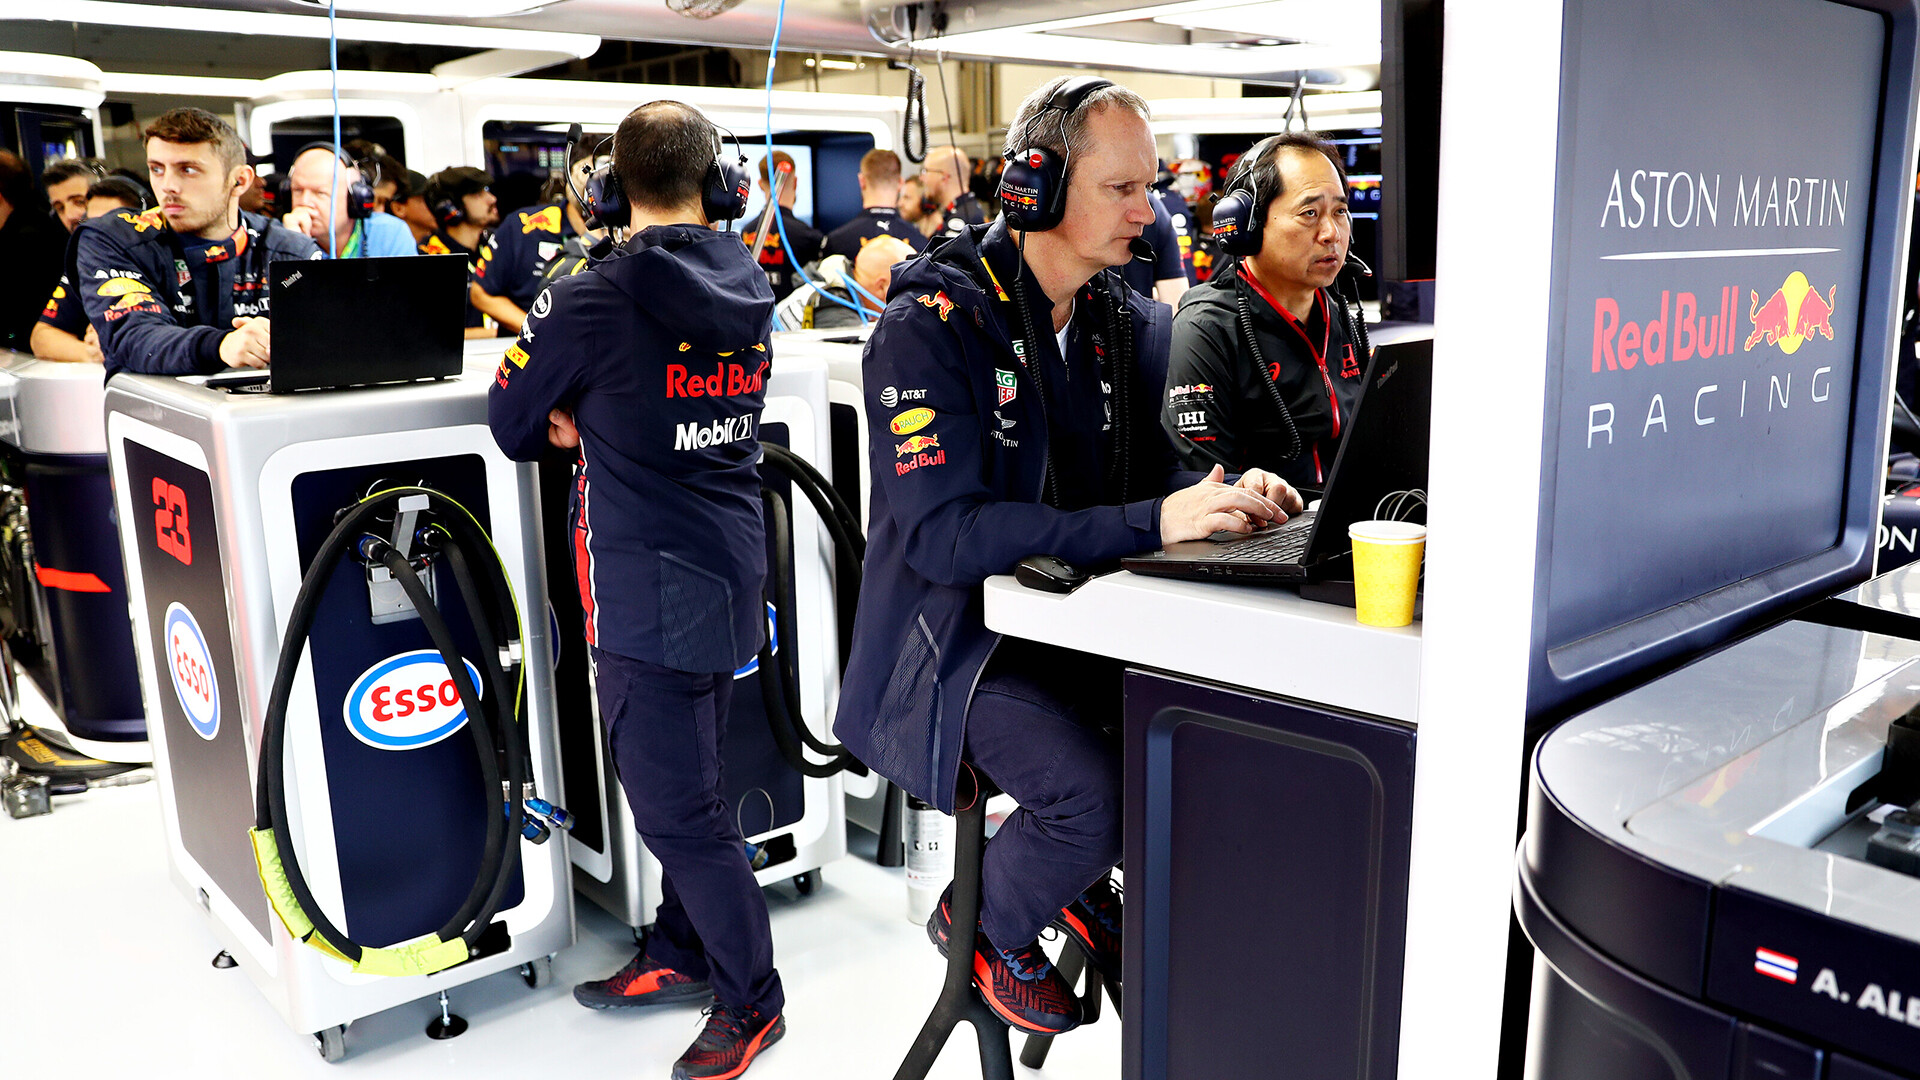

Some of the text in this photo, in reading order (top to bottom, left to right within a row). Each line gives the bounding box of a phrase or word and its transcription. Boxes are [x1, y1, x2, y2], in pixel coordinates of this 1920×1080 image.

[1004, 200, 1037, 211] ACING
[1015, 185, 1038, 194] MARTIN
[1600, 169, 1848, 228] ASTON MARTIN
[1591, 285, 1739, 373] Red Bull
[666, 361, 770, 398] Red Bull
[901, 389, 928, 401] AT&T
[899, 411, 930, 429] RAUCH
[1178, 411, 1206, 426] IHI
[1587, 366, 1831, 449] RACING
[674, 417, 737, 451] Mobil
[895, 449, 946, 476] Red Bull
[152, 476, 193, 566] 23
[174, 634, 209, 704] Esso
[370, 678, 460, 723] Esso
[1811, 967, 1851, 1004] A.
